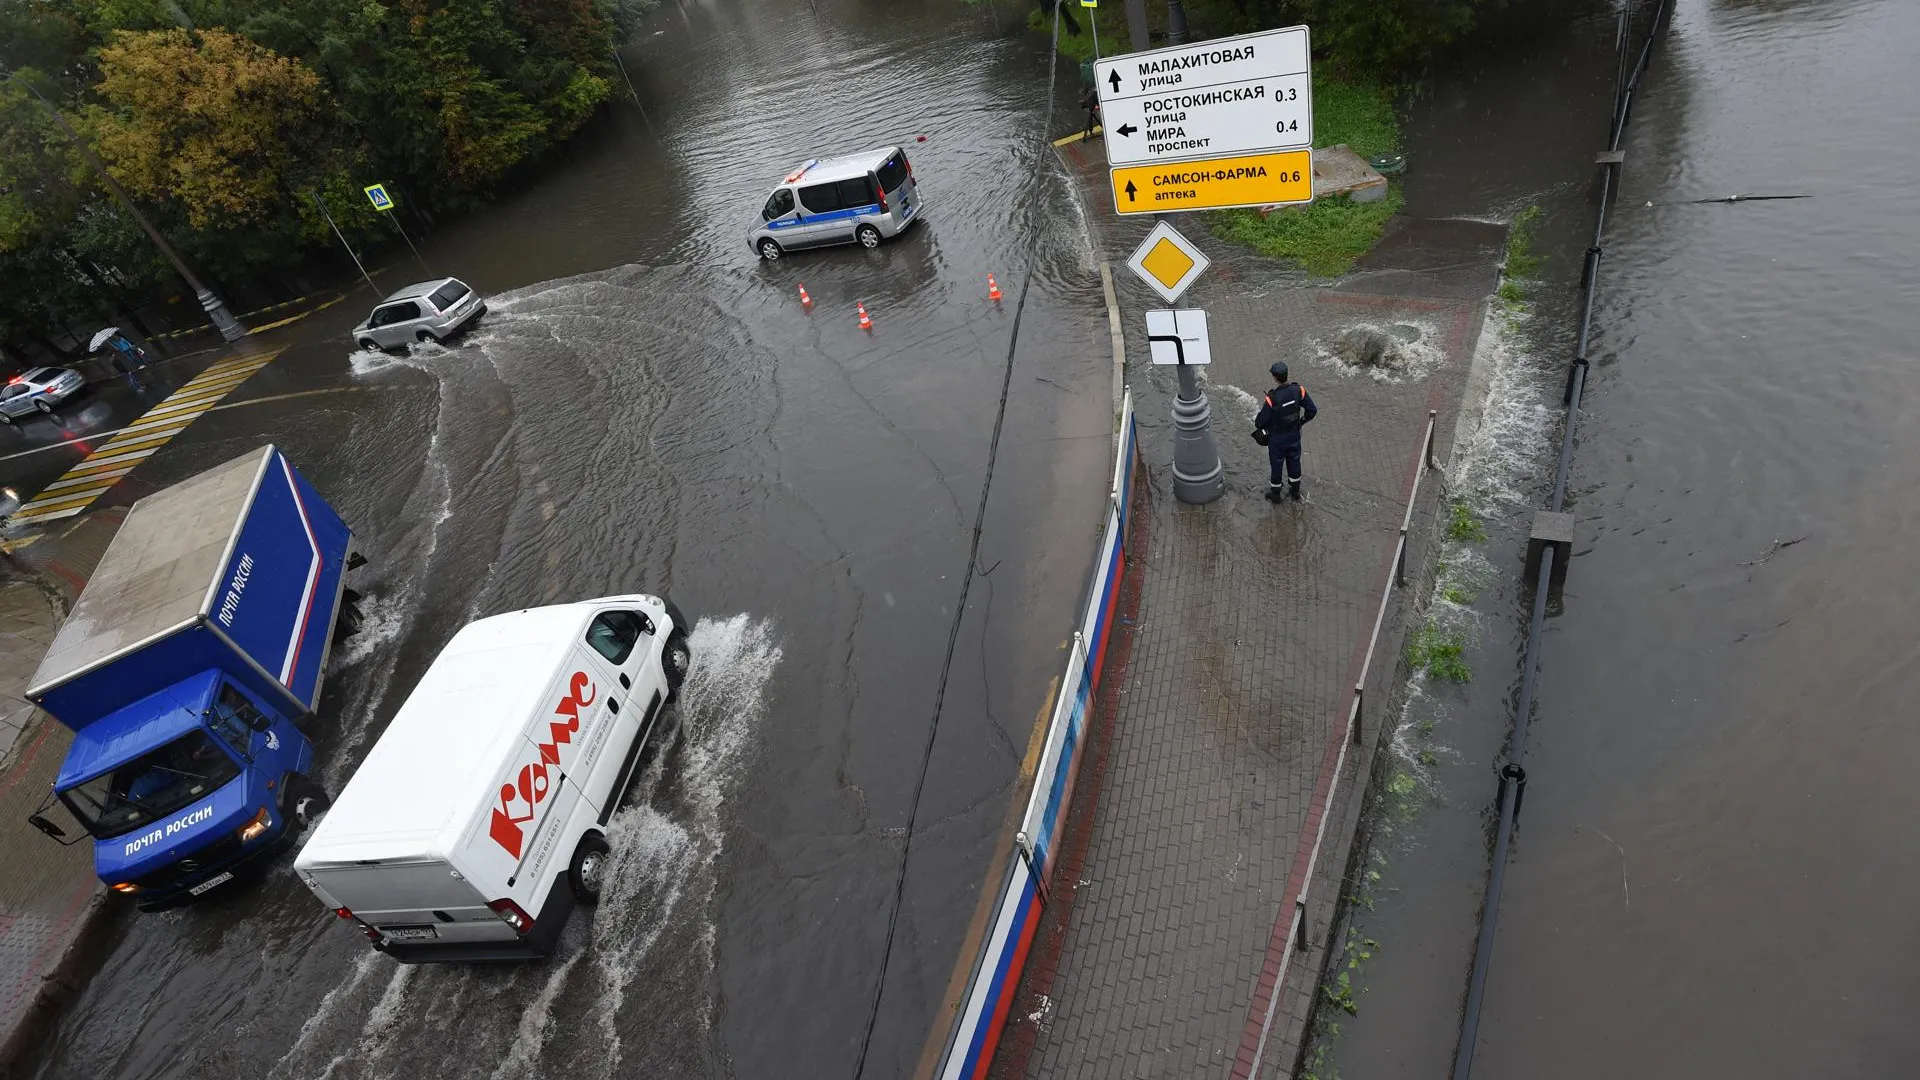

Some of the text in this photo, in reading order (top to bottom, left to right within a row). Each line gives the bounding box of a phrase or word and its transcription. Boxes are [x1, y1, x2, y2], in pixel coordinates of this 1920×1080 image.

[1138, 46, 1255, 76] МАЛАХИТОВАЯ
[1140, 73, 1183, 91] улица
[1143, 86, 1297, 113] РОСТОКИНСКАЯ 0.3
[1145, 112, 1187, 128] улица
[1146, 120, 1298, 142] МИРА 0.4
[1148, 138, 1211, 155] проспект
[1152, 166, 1301, 187] САМСОН-ФАРМА 0.6
[1154, 189, 1197, 201] аптека
[218, 552, 255, 628] ПОЧТА РОССИИ
[124, 805, 214, 857] ПОЧТА РОССИИ
